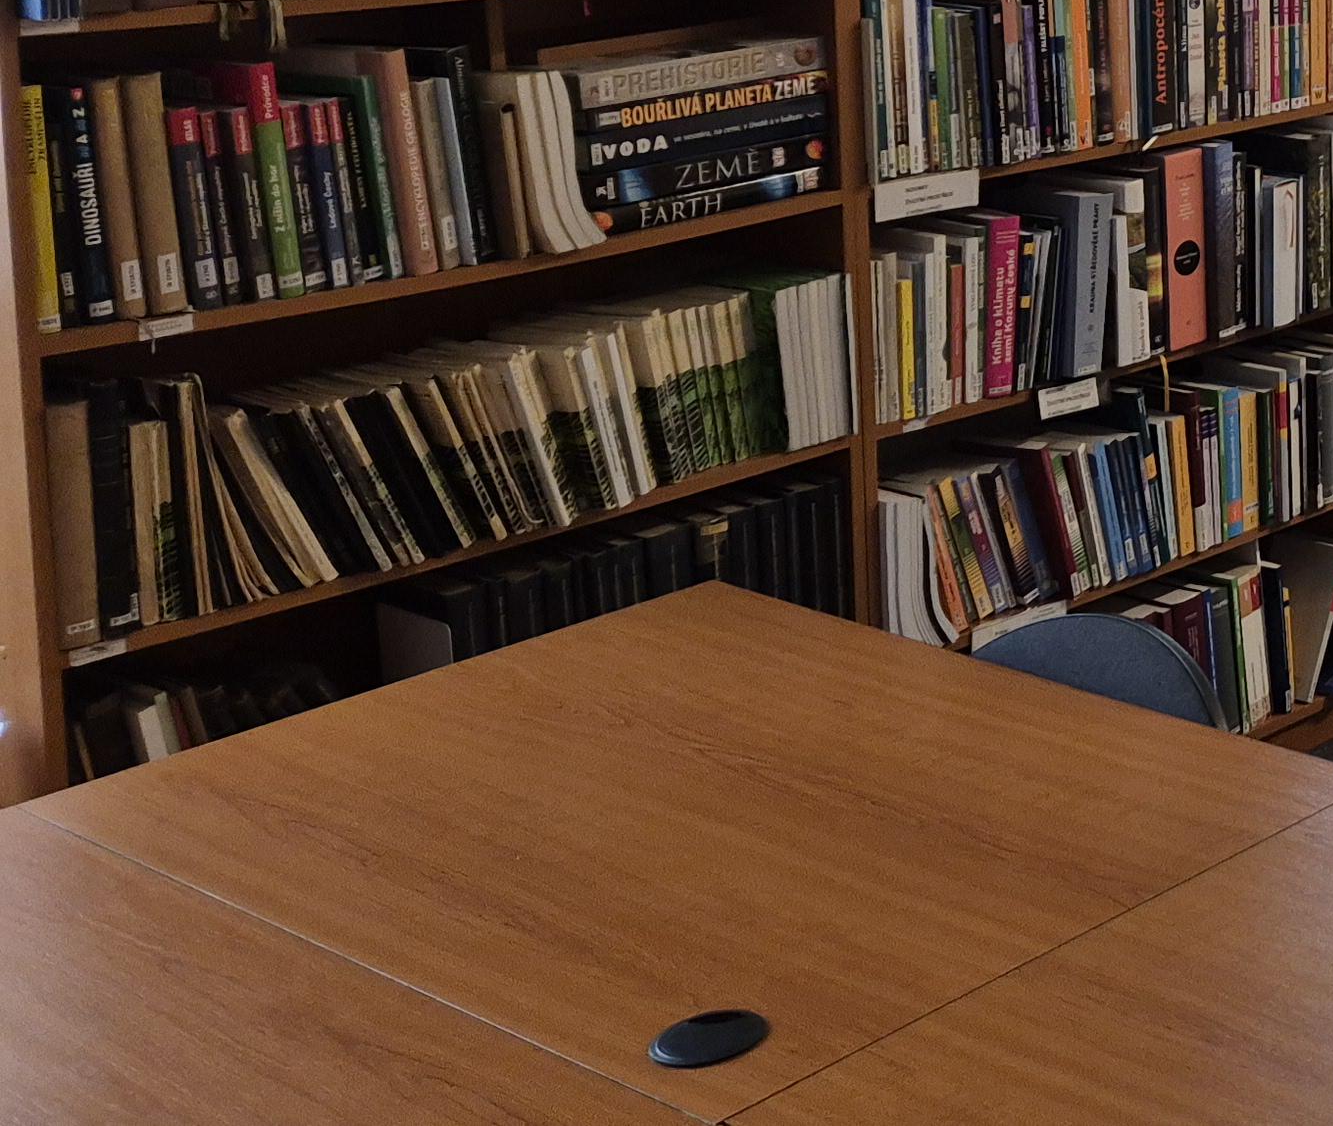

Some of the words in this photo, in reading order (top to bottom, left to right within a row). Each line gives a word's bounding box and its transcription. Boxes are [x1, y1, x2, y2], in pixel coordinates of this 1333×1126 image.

[613, 51, 765, 98] PREHISTORIE
[1217, 35, 1226, 91] Planeta
[72, 107, 84, 117] Z
[259, 74, 274, 119] Průvodce
[400, 90, 415, 145] GEOLOGIE
[621, 92, 701, 129] BOUŘLIVÁ
[704, 83, 773, 114] PLANETA
[74, 134, 88, 144] A
[602, 135, 669, 161] VODA
[267, 165, 278, 182] hor
[270, 184, 281, 197] do
[407, 148, 427, 227] ENCYKLOPEDIE
[675, 147, 761, 191] ZEMĚ
[73, 163, 103, 246] DINOSAUŘI
[639, 192, 722, 229] EARTH
[1092, 203, 1100, 229] PRAHY
[992, 267, 1004, 317] klimatu
[1004, 287, 1016, 332] Koruny
[991, 331, 1003, 365] Kniha
[1003, 335, 1013, 363] zemí
